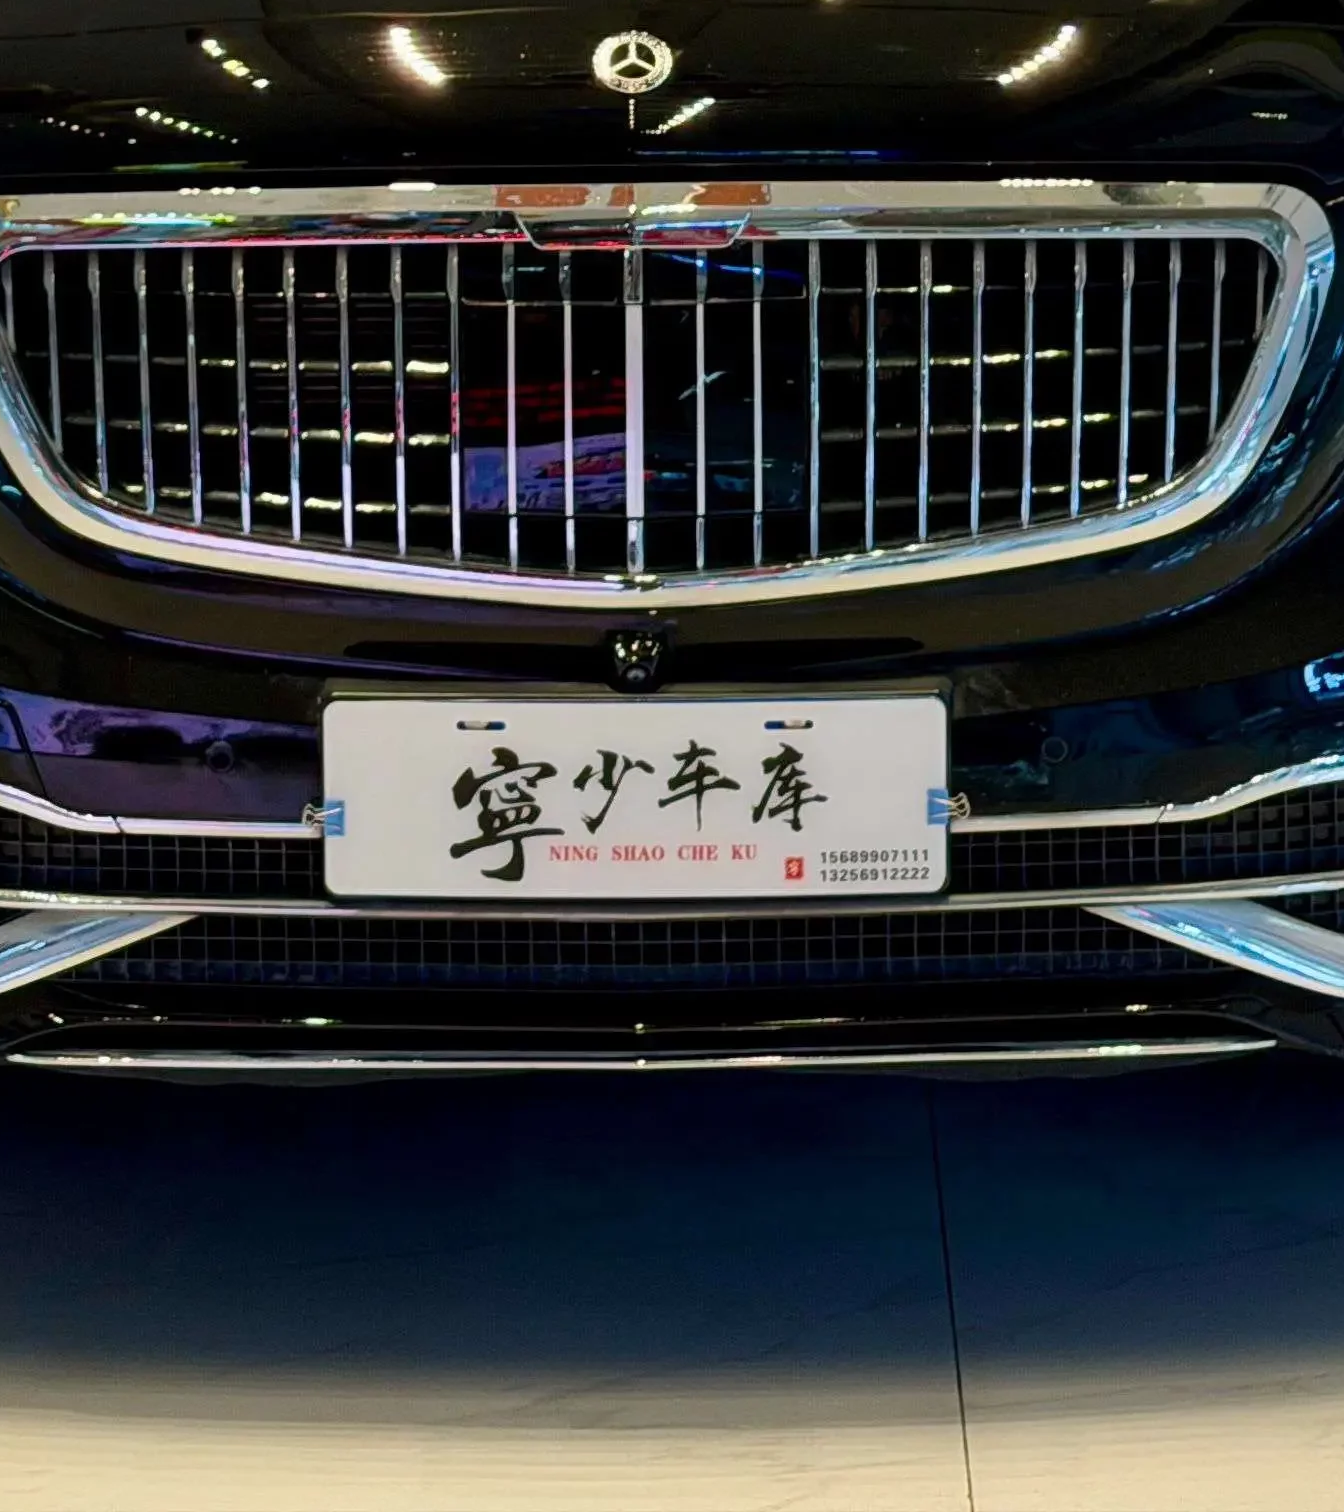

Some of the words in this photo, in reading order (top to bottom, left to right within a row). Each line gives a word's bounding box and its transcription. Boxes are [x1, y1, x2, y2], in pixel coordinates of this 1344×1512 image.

[548, 844, 599, 862] NING
[611, 844, 666, 862] SHAO
[677, 843, 720, 861] CHE
[731, 843, 758, 860] KU
[820, 849, 930, 864] 15689907111
[819, 867, 931, 882] 13256912222
